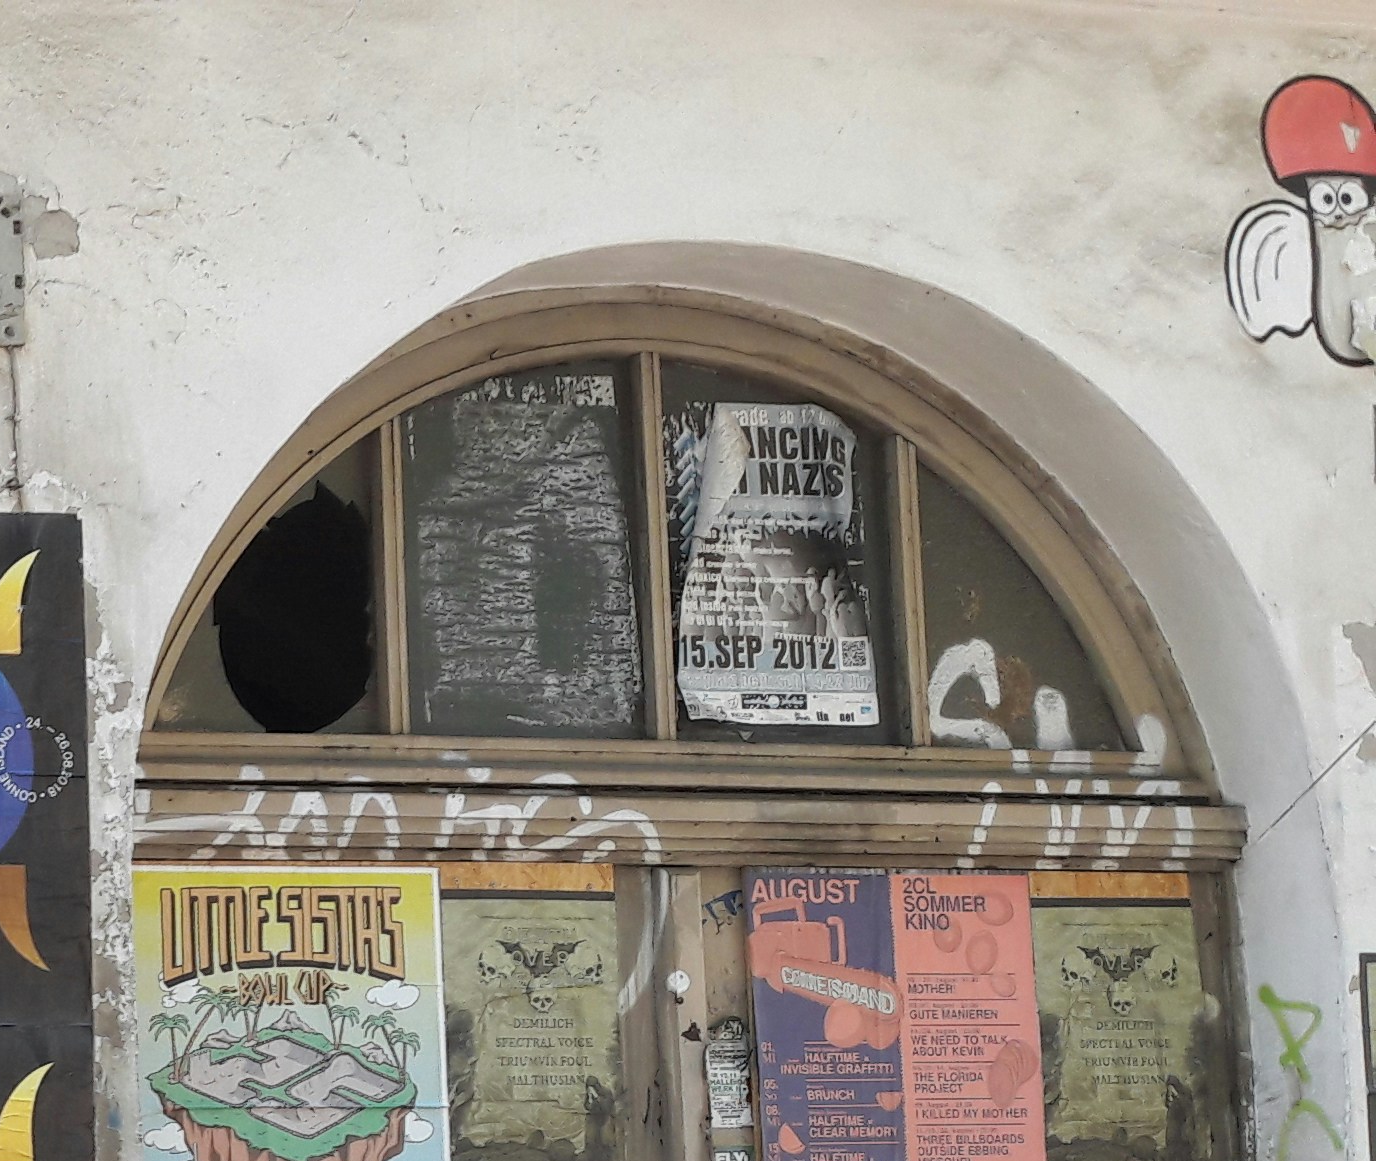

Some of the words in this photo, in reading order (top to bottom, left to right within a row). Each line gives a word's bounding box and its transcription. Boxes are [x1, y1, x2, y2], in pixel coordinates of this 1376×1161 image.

[760, 463, 844, 496] NAZIS
[681, 634, 761, 669] 15.SEP
[774, 636, 836, 669] 2012
[0, 772, 37, 803] CONNE
[751, 879, 859, 903] AUGUST
[903, 878, 937, 894] 2CL
[904, 895, 986, 912] SOMMER
[906, 913, 950, 930] KINO
[159, 886, 274, 989] LITTLE
[510, 949, 569, 968] OVER
[237, 971, 293, 1007] BOWL
[296, 969, 332, 1006] CUP
[909, 1010, 938, 1020] GUTE
[942, 1009, 998, 1020] MANIEREN
[513, 1017, 574, 1030] DEMILICH
[495, 1037, 556, 1049] SPECTRAL
[558, 1036, 593, 1048] VOICE
[937, 1072, 983, 1082] FLORIDA
[915, 1083, 963, 1093] PROJECT
[809, 1127, 847, 1138] CLEAR
[850, 1126, 898, 1137] MEMORY
